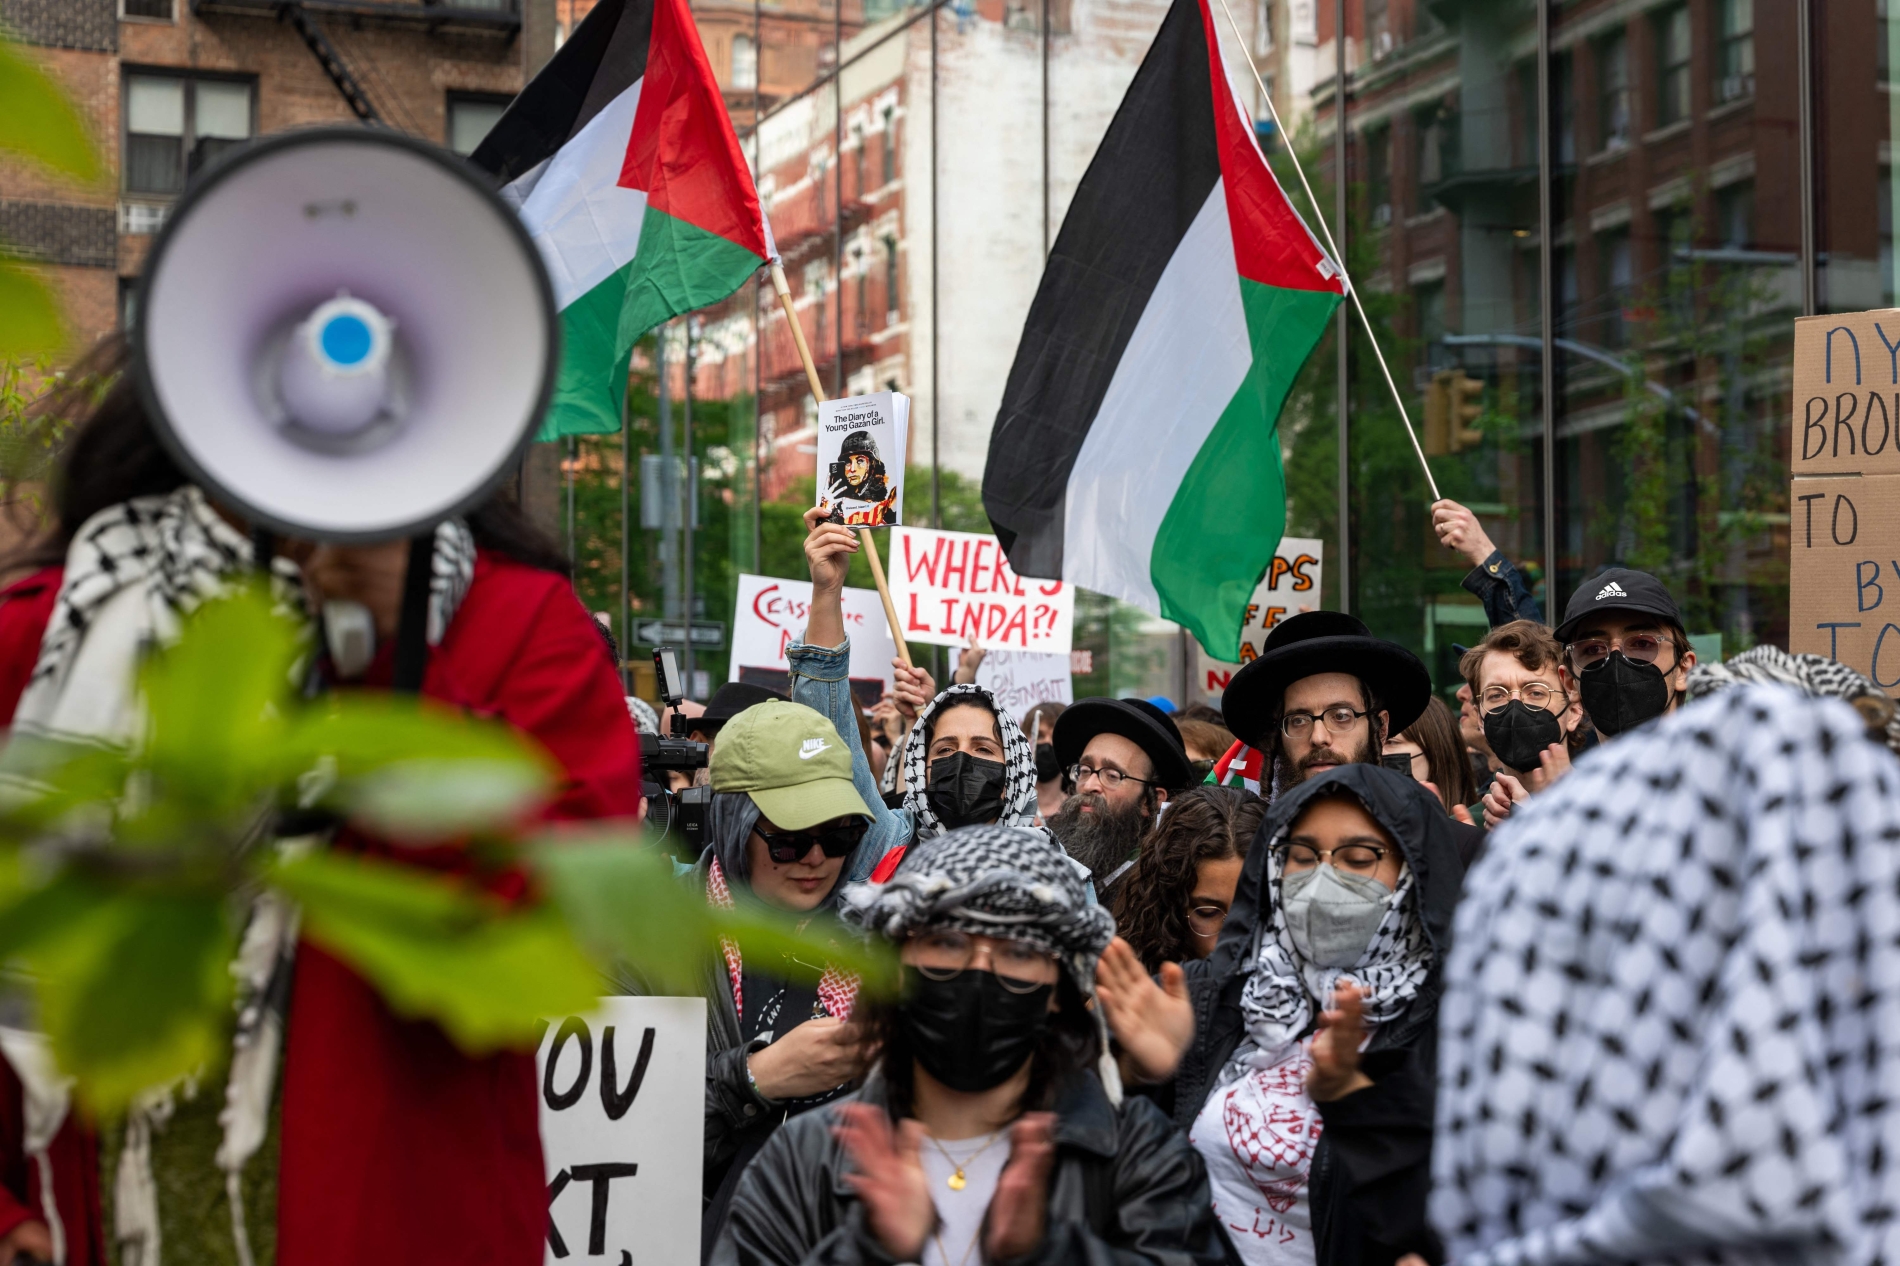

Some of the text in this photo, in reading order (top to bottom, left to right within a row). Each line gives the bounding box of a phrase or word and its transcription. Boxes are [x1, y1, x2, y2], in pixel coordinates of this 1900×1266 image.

[834, 415, 848, 423] The
[848, 412, 867, 422] Diary
[867, 410, 874, 419] of
[825, 417, 885, 433] Young Gazan Girl.
[1798, 493, 1857, 548] TO
[1258, 553, 1319, 592] PS
[1595, 590, 1628, 601] adidas
[908, 592, 1058, 647] LINDA?!
[802, 737, 825, 751] NIKE
